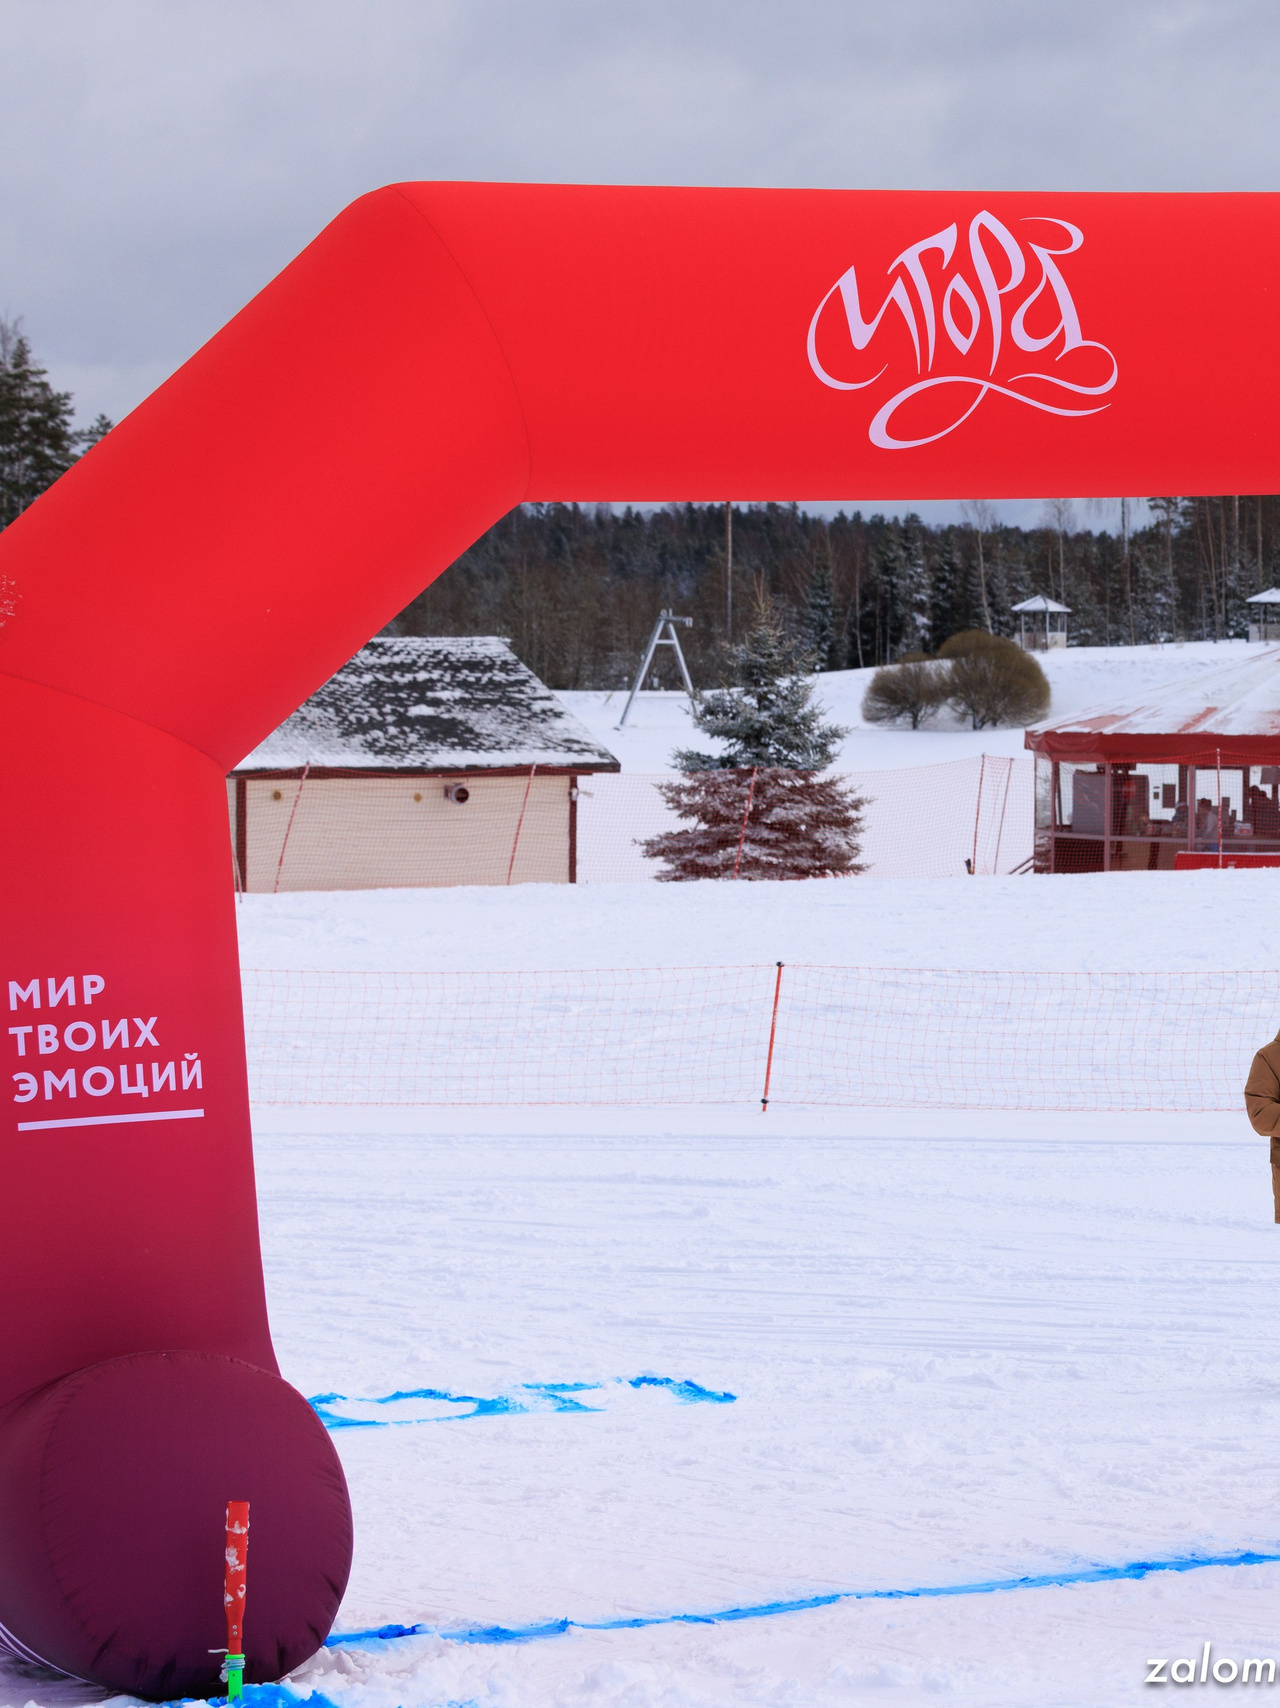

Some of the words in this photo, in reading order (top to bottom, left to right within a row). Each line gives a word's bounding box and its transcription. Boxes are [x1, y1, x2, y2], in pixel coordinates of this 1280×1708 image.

[8, 974, 106, 1011] МИР
[8, 1016, 160, 1057] ТВОИХ
[12, 1052, 203, 1103] ЭМОЦИЙ
